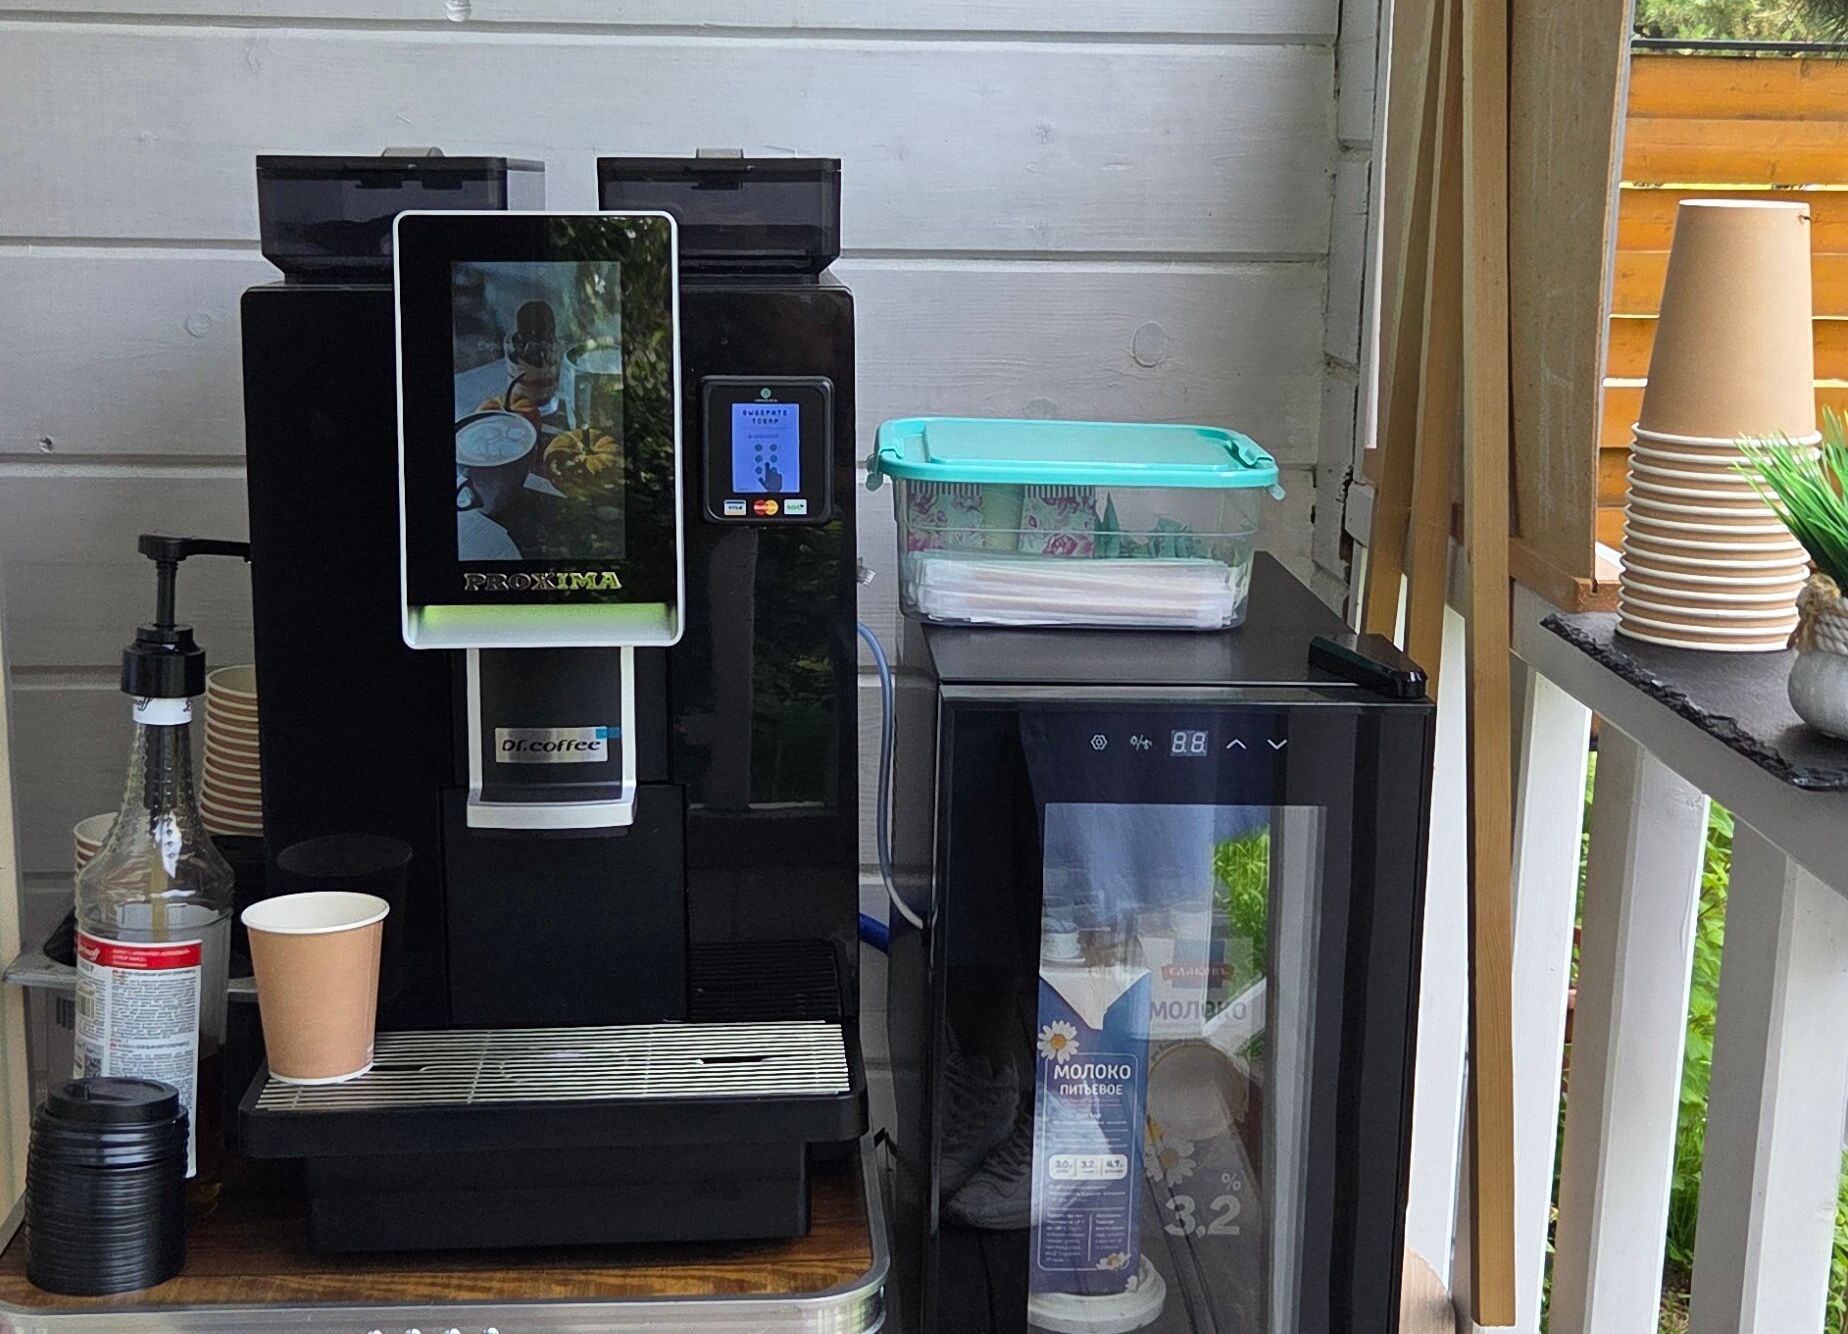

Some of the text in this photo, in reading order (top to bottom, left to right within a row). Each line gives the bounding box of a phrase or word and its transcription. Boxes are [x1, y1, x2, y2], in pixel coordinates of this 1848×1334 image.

[463, 571, 623, 592] PROXIMA
[501, 739, 602, 753] Dr.coffee
[1053, 1063, 1132, 1081] МОЛОКО
[1059, 1083, 1124, 1096] ПИТЬЕВОЕ
[1221, 1172, 1242, 1192] %
[1163, 1194, 1241, 1239] 3,2
